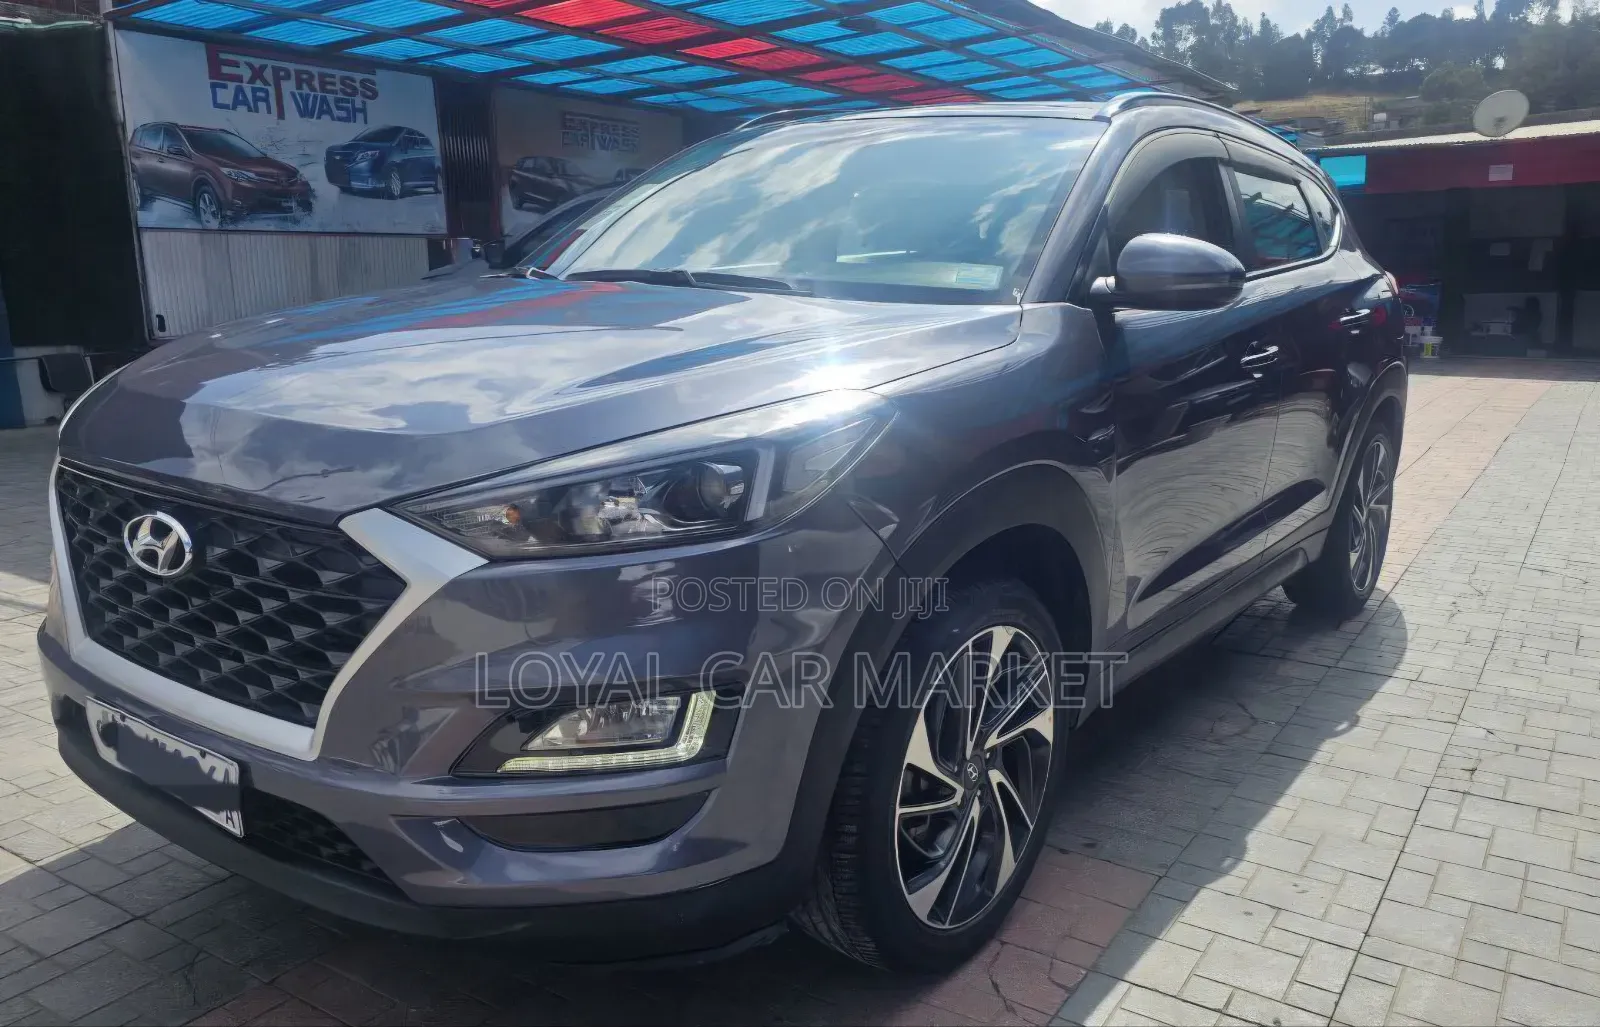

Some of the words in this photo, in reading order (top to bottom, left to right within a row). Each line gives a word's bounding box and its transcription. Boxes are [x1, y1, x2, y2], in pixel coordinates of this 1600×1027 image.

[205, 44, 379, 119] EXPRESS
[209, 81, 272, 115] CAR
[290, 90, 368, 125] WASH
